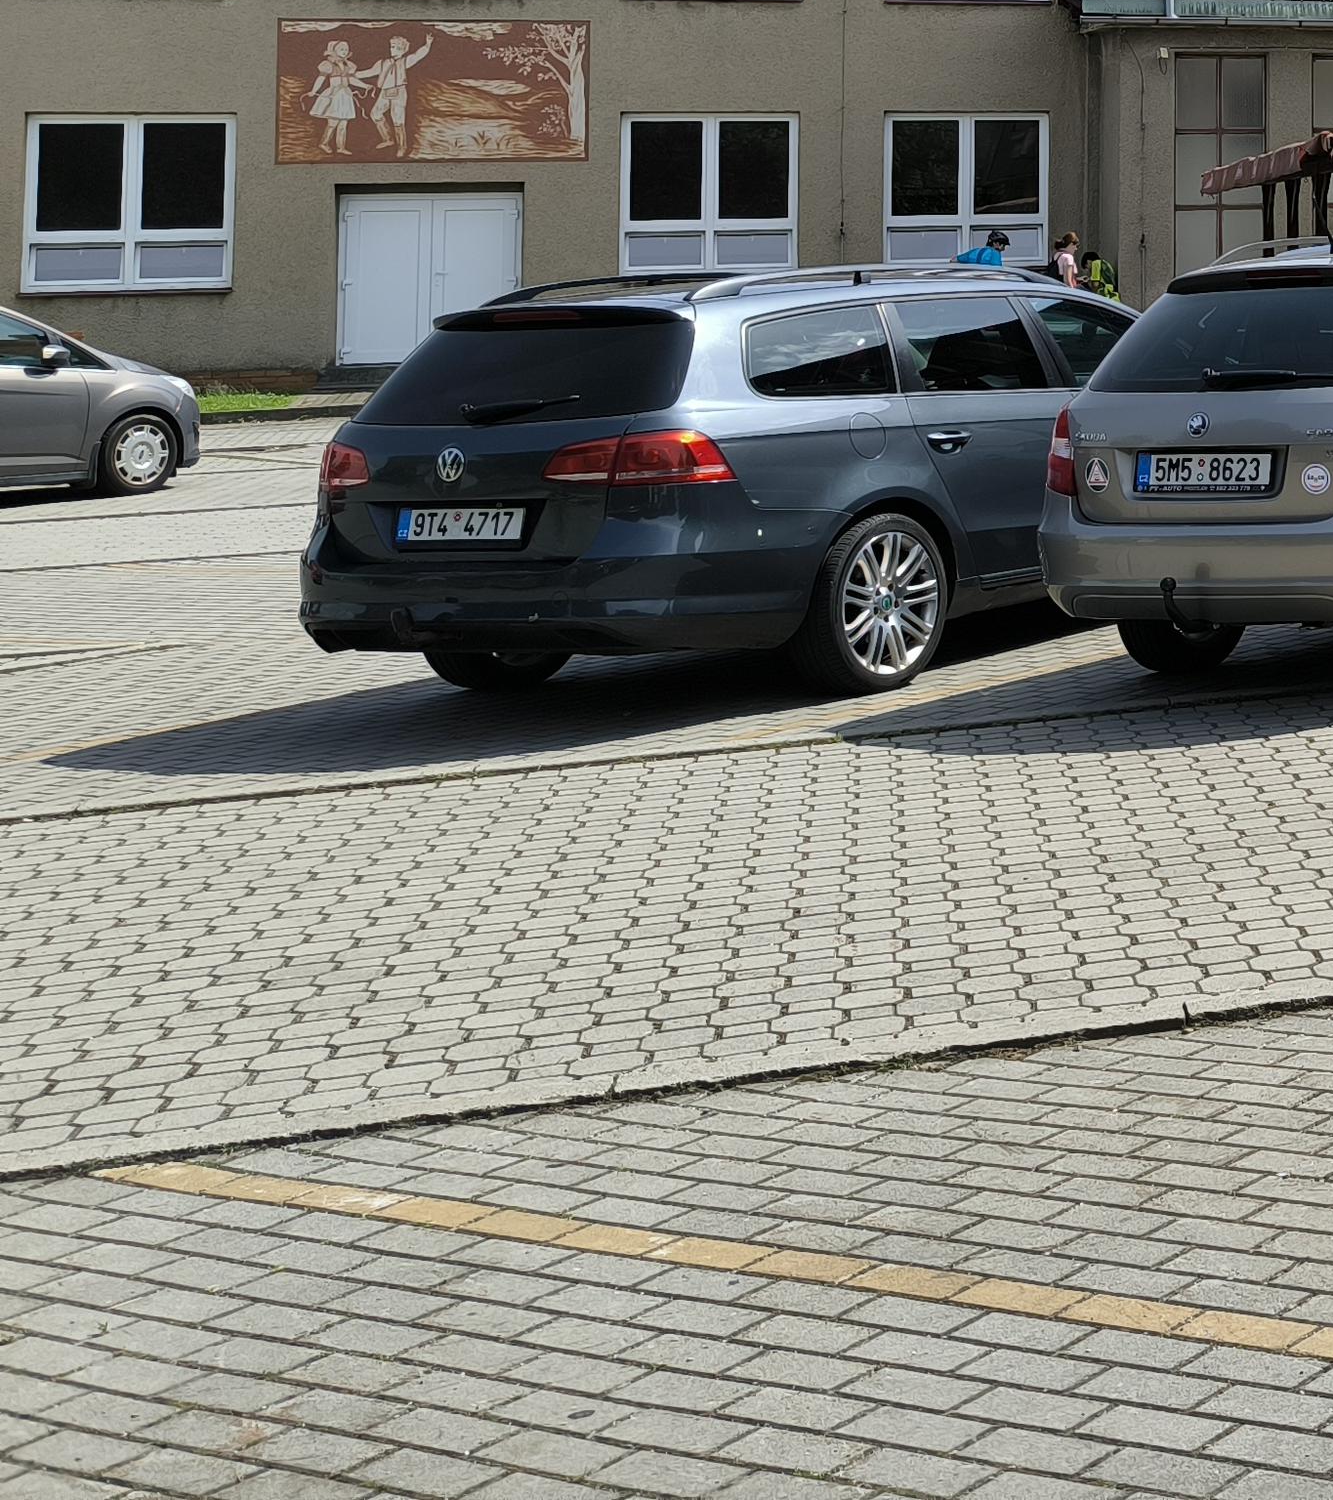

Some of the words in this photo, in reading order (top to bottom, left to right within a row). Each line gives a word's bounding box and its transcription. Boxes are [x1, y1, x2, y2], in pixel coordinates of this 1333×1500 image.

[1155, 457, 1193, 482] 5M5
[1208, 457, 1261, 482] 8623
[413, 511, 448, 537] 9T4
[463, 510, 515, 536] 4717
